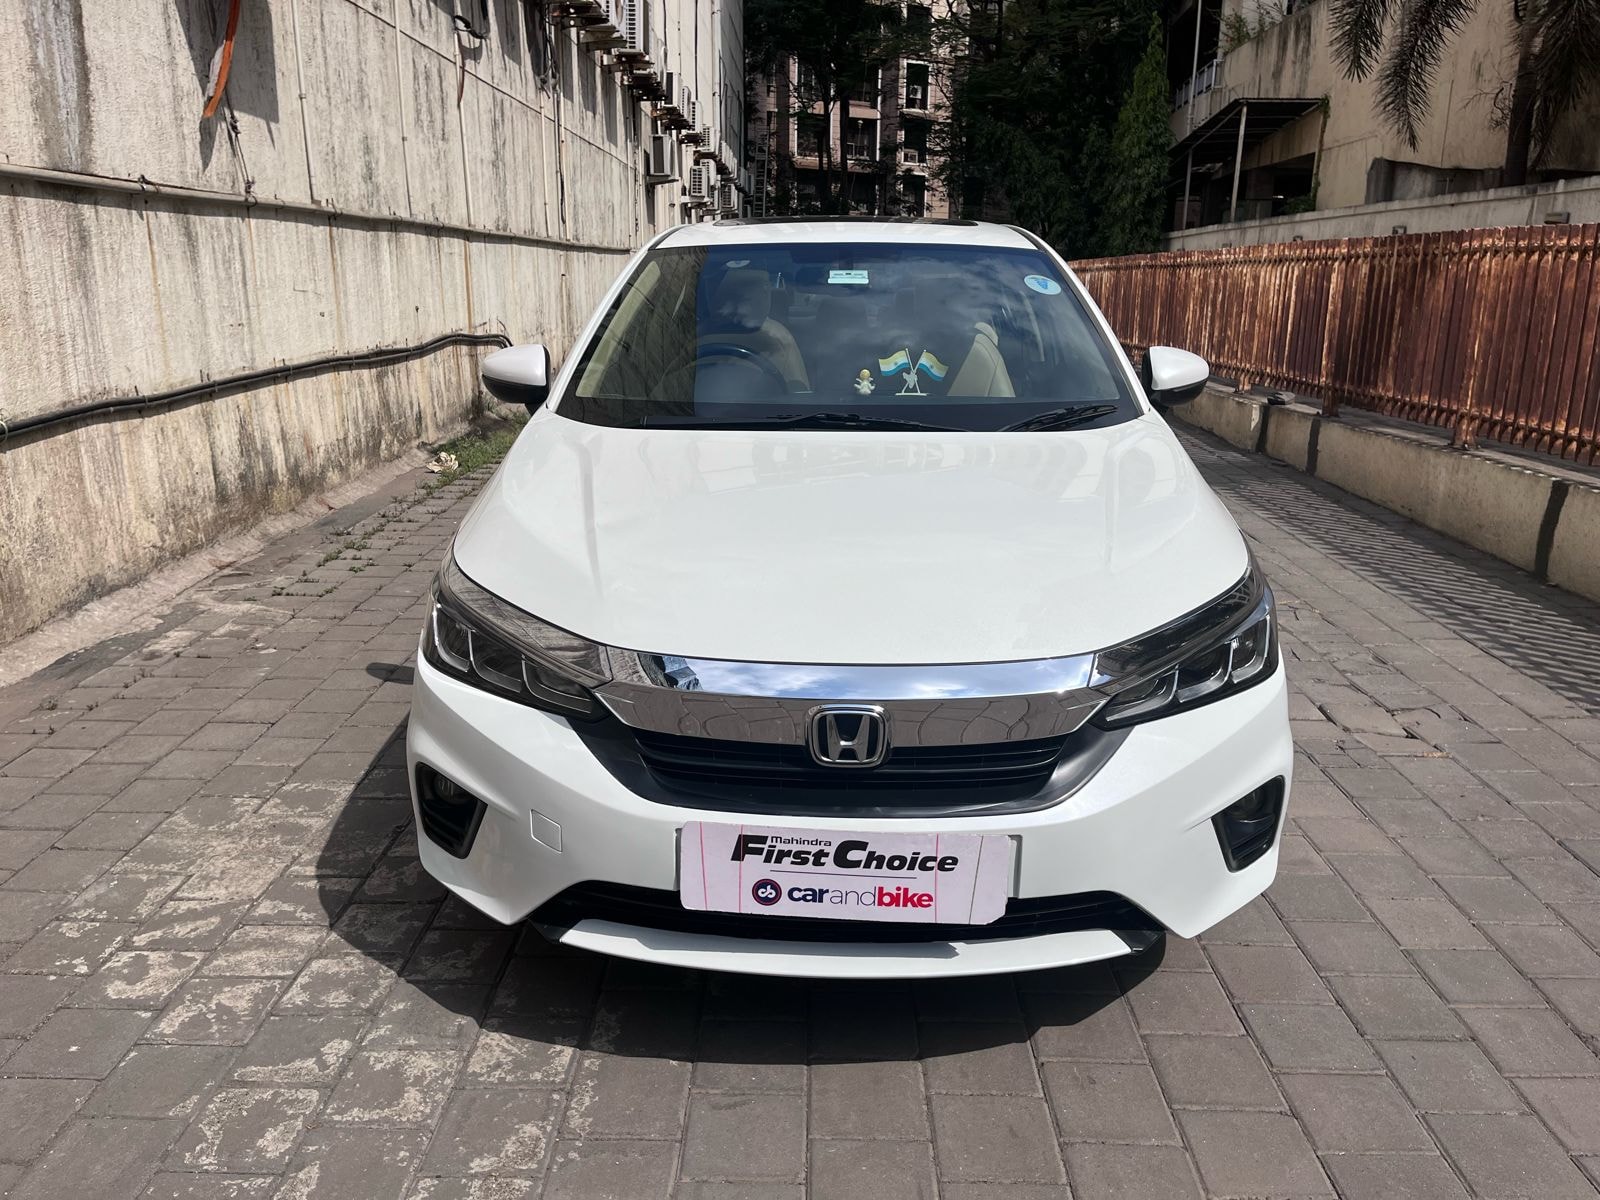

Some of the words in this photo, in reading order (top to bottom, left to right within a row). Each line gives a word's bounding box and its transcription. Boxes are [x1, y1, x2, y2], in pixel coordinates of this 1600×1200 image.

[730, 833, 830, 868] First
[832, 840, 959, 873] Choice
[770, 835, 832, 847] Mahindra
[787, 885, 934, 909] carandbike
